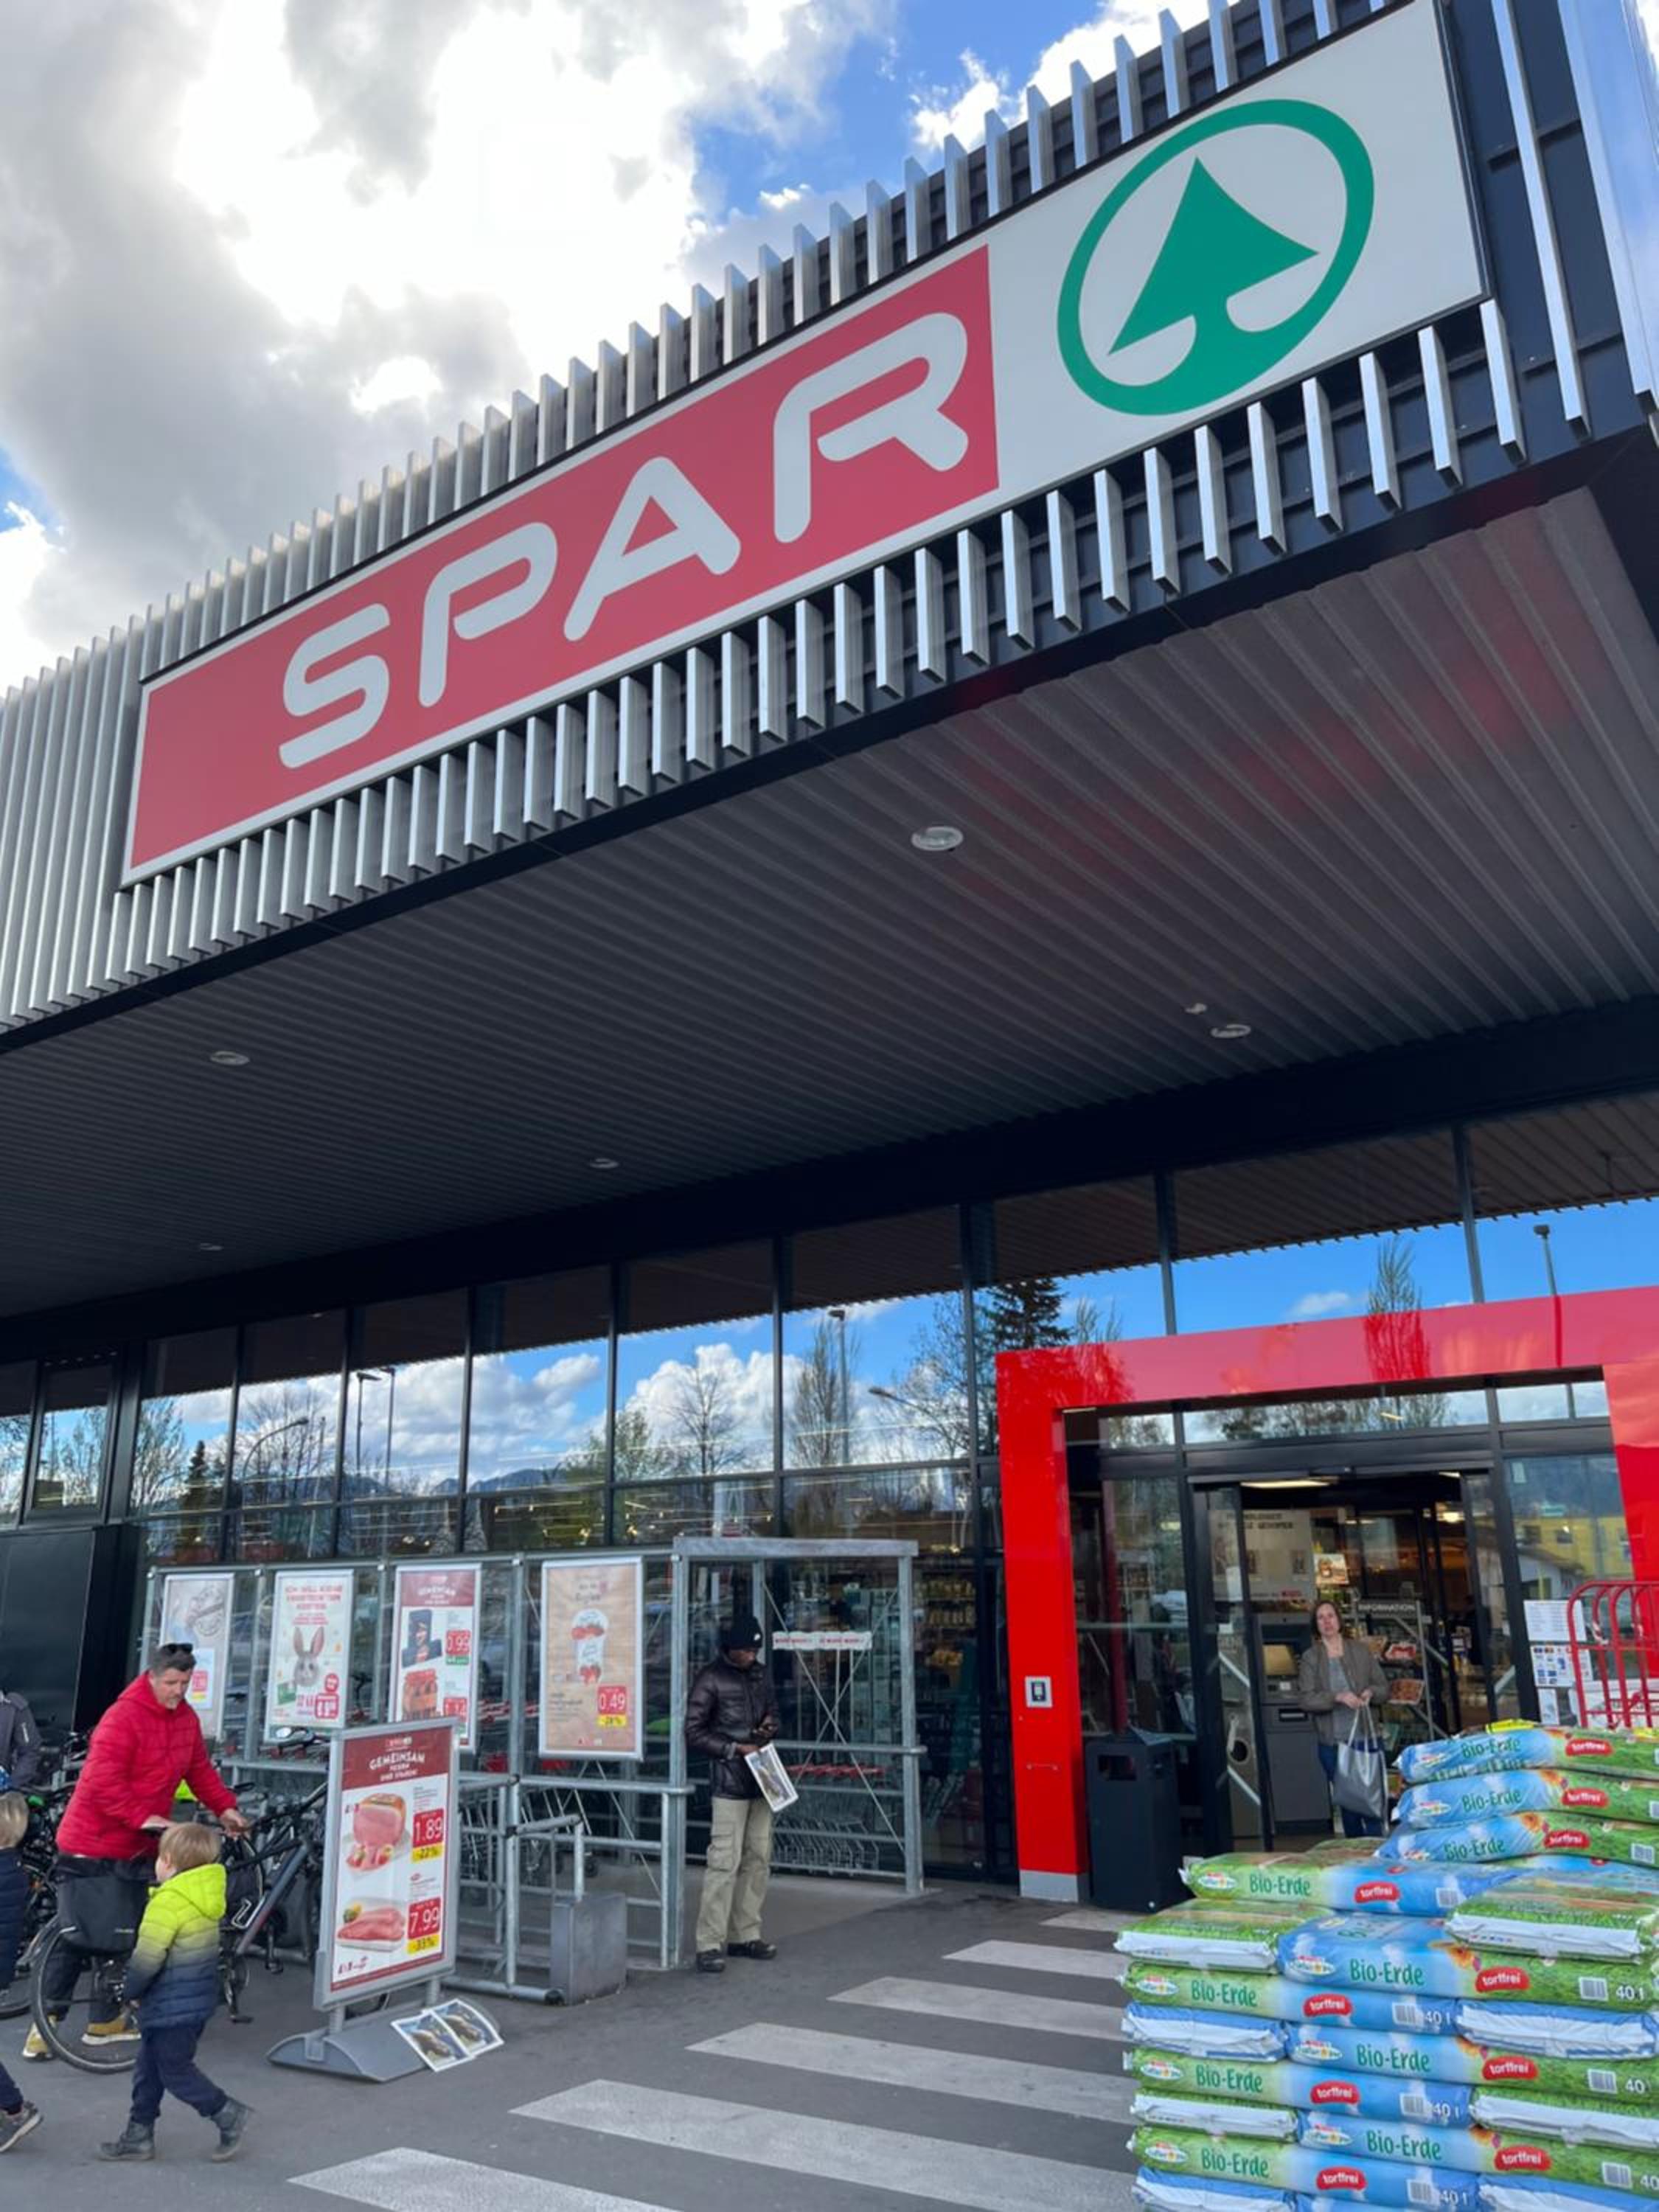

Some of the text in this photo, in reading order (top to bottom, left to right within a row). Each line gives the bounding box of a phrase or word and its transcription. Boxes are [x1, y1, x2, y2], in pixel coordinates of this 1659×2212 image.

[279, 311, 969, 769] SPAR
[599, 1693, 625, 1711] 0.49
[1462, 1736, 1521, 1759] Bio-Erde
[369, 1751, 425, 1770] GEMEINSAM
[1462, 1790, 1522, 1812] Bio-Erde
[1568, 1790, 1601, 1802] torffrei
[415, 1817, 442, 1843] 1.89
[1550, 1832, 1582, 1843] torffrei
[1444, 1837, 1505, 1860] Bio-Erde
[1250, 1874, 1311, 1897] Bio-Erde
[1360, 1885, 1393, 1898] torffrei
[410, 1907, 439, 1934] 7.99
[1350, 1958, 1425, 1986] Bio-Erde
[1482, 1972, 1521, 1986] torffrei
[1191, 1979, 1257, 2007] Bio-Erde
[1615, 1985, 1634, 2000] 40
[1310, 1997, 1346, 2011] torffrei
[1425, 2011, 1442, 2025] 40
[1357, 2043, 1431, 2073] Bio-Erde
[1489, 2061, 1529, 2074] torffrei
[1196, 2064, 1263, 2093] Bio-Erde
[1625, 2079, 1645, 2094] 40
[1317, 2086, 1353, 2099] torffrei
[1432, 2102, 1450, 2118] 40
[1367, 2130, 1441, 2161] Bio-Erde
[1201, 2147, 1269, 2178] Bio-Erde
[1502, 2152, 1542, 2165] torffrei
[1322, 2171, 1359, 2185] torffrei
[1640, 2175, 1659, 2190] 40
[1441, 2191, 1458, 2205] 40
